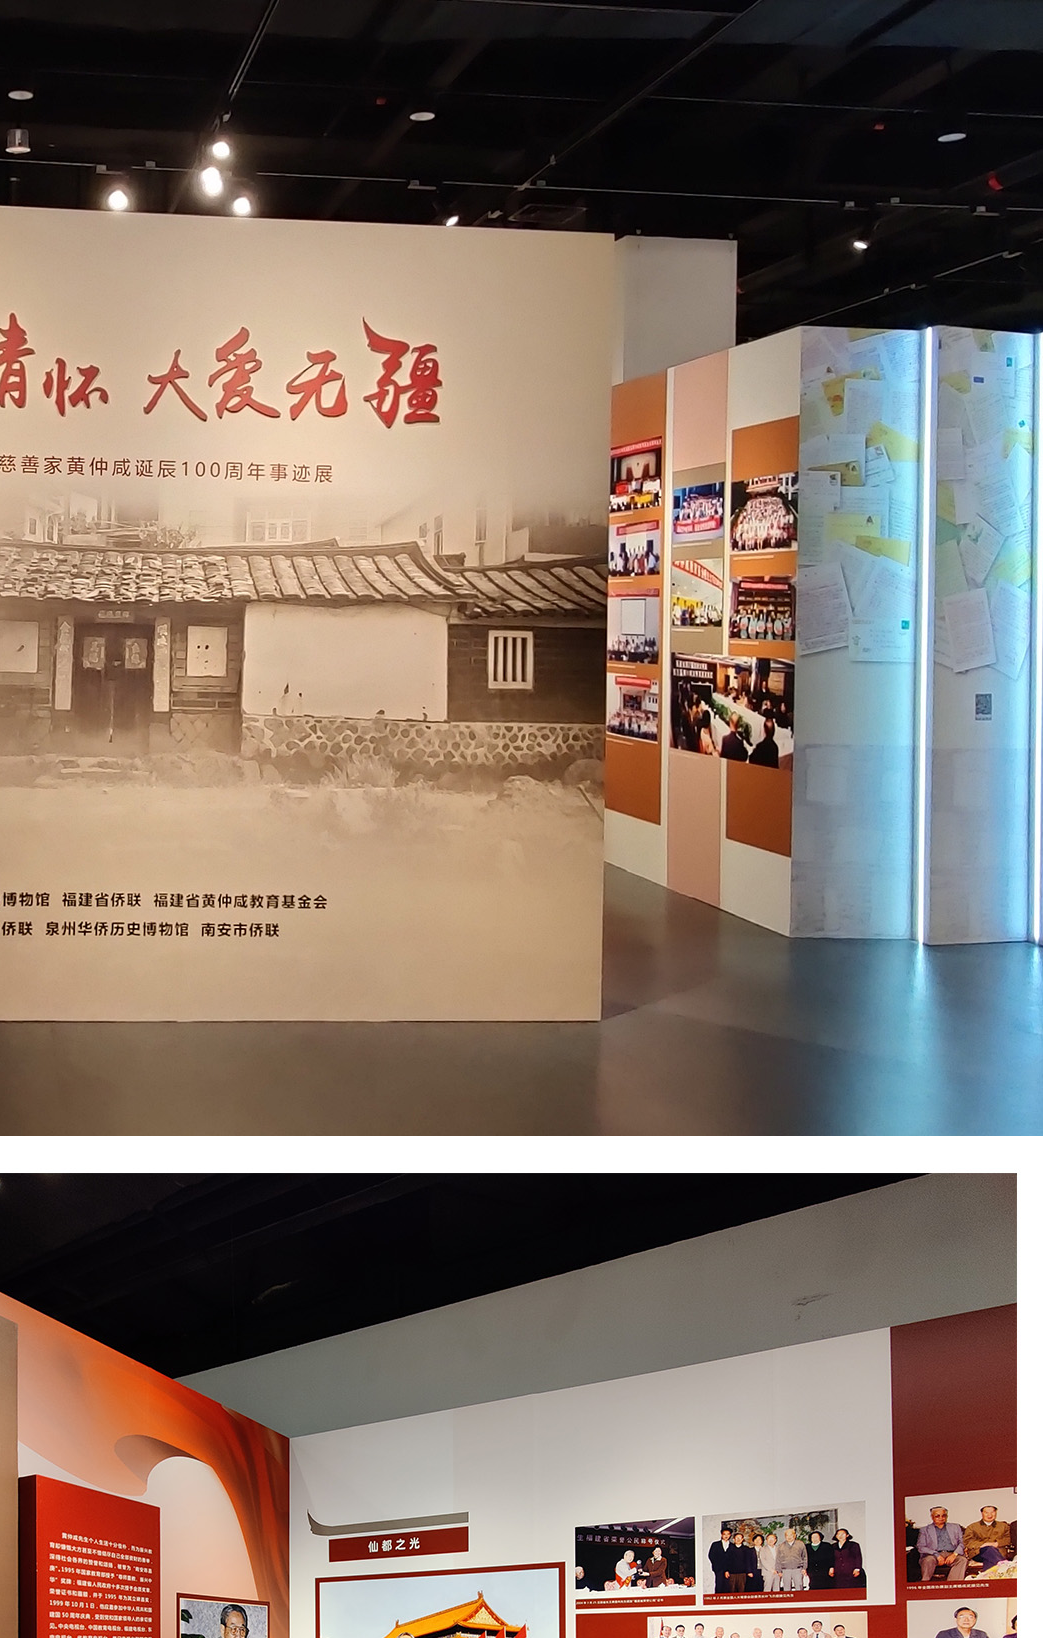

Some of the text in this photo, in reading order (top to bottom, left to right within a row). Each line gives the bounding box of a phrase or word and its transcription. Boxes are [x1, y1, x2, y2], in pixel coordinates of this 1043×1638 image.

[143, 315, 444, 429] 大爱无疆
[61, 891, 142, 909] 福建省侨联
[153, 892, 329, 911] 福建省黄仲咸教育基金会
[44, 920, 190, 938] 泉州华侨历史博物馆
[200, 921, 280, 939] 南安市侨联
[368, 1536, 421, 1553] 仙都之光
